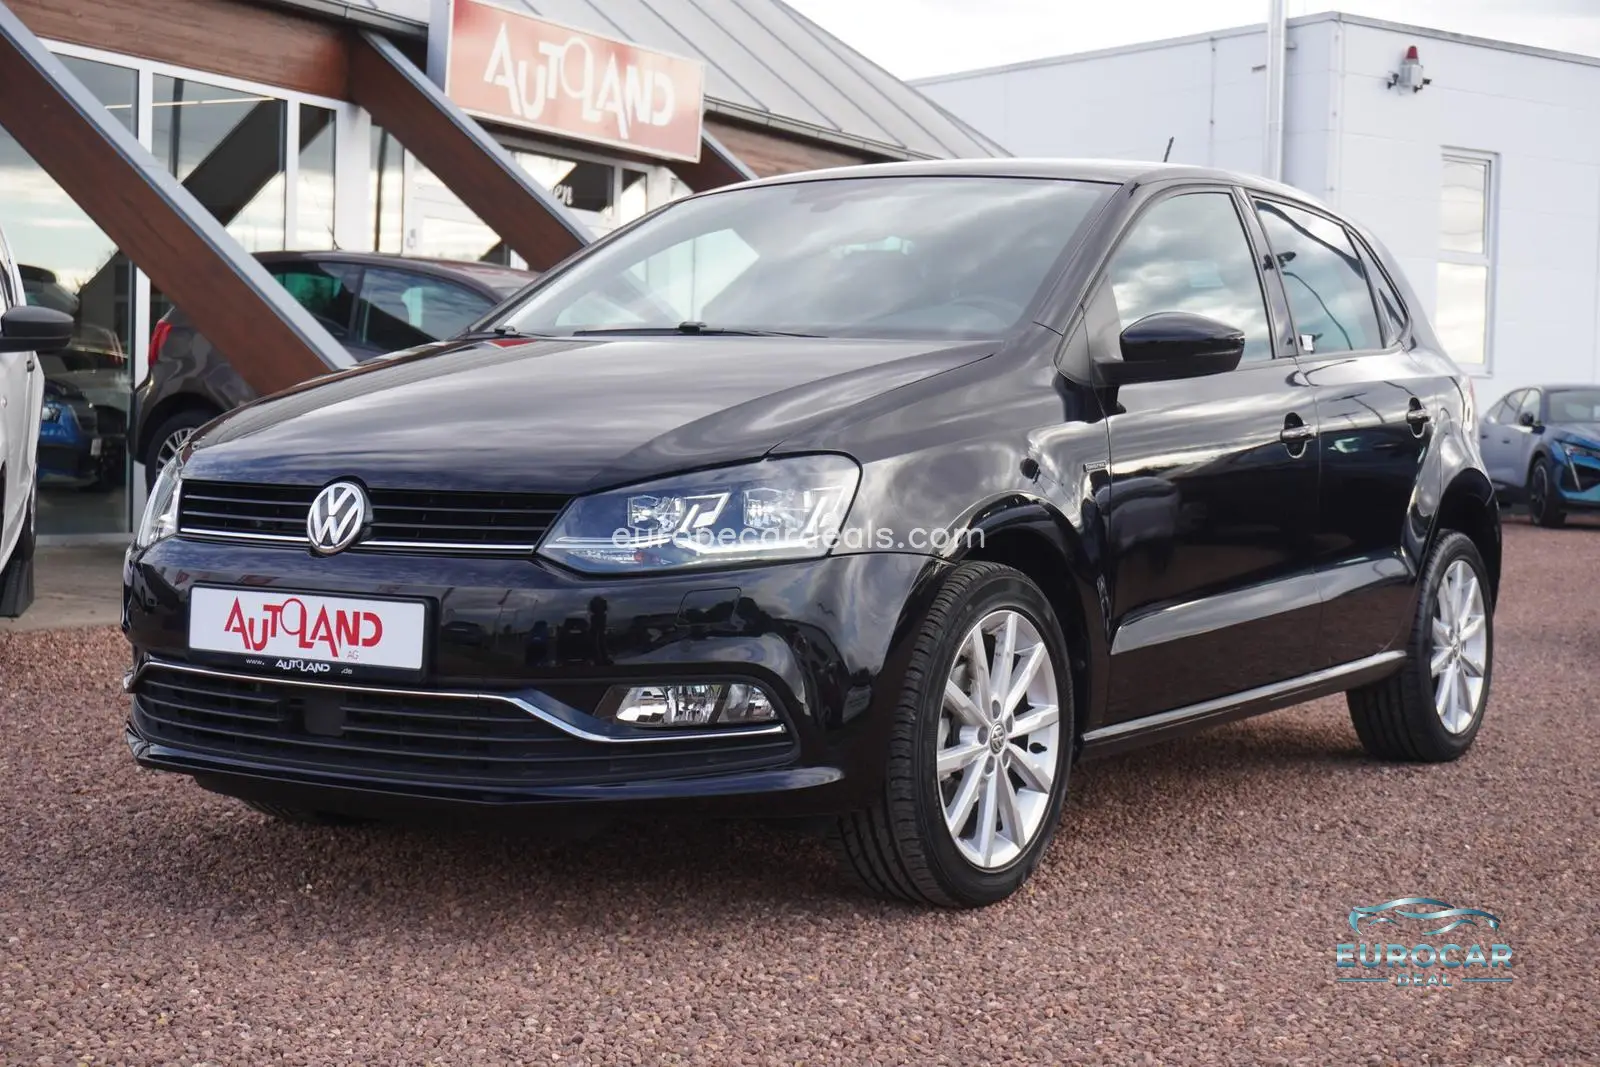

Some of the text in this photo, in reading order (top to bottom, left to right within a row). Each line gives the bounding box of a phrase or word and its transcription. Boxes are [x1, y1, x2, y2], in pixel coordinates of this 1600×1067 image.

[484, 23, 675, 139] AUTOLAND
[309, 484, 362, 546] VW
[224, 597, 383, 657] AUTOLAND
[347, 650, 359, 659] AG
[275, 659, 331, 673] AUTOLAND
